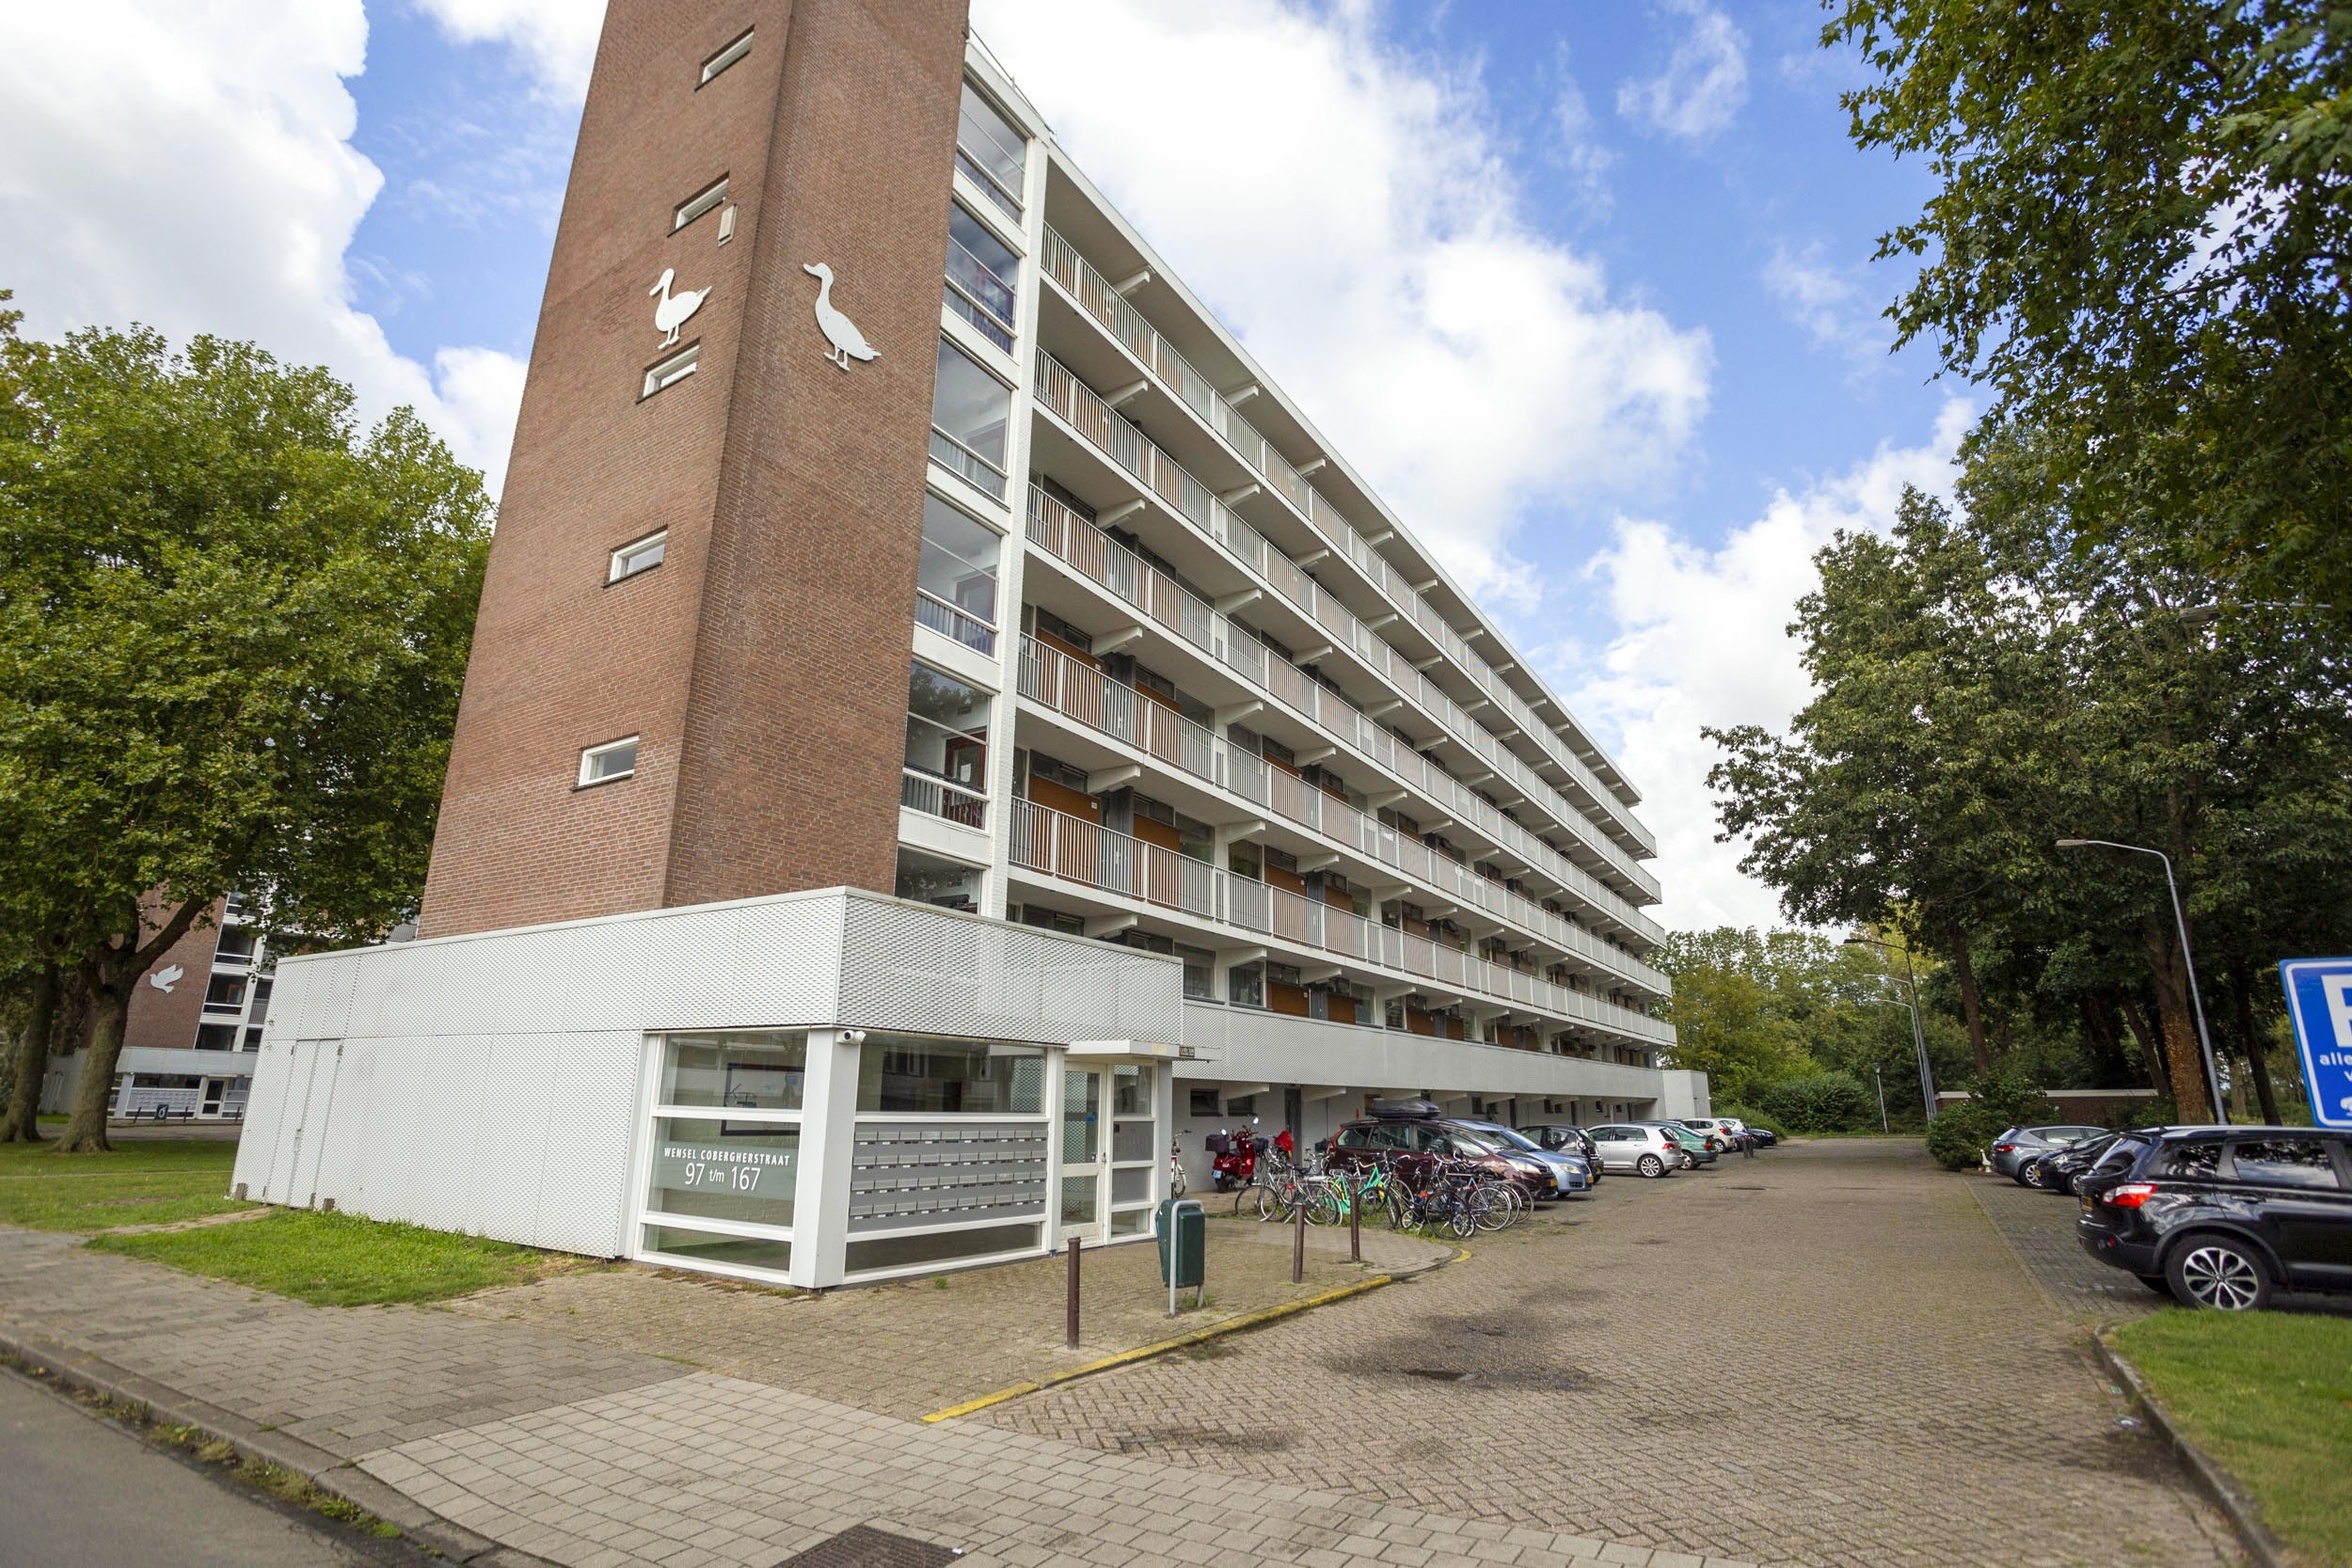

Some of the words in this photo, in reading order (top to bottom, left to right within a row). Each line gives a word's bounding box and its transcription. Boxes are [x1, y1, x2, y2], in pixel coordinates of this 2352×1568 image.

[664, 1147, 696, 1160] WENSEL
[700, 1149, 790, 1166] COBERGHERSTRAAT
[684, 1162, 706, 1186] 97
[708, 1168, 724, 1182] t/m
[731, 1165, 761, 1191] 167
